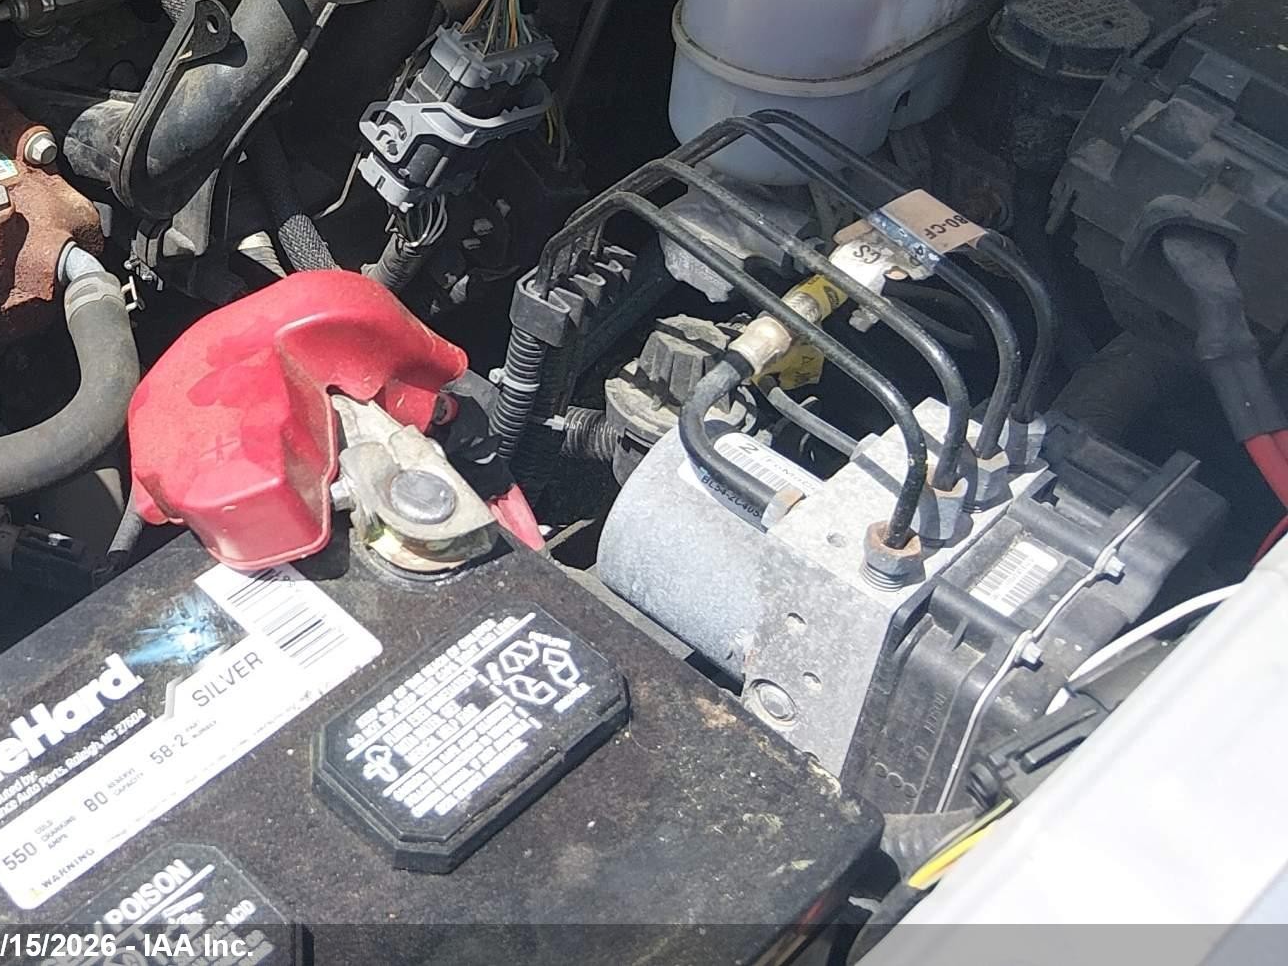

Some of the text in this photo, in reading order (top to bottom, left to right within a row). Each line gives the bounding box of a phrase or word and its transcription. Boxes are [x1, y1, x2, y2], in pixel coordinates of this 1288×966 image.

[191, 650, 265, 708] SILVER
[14, 780, 43, 805] Auto
[99, 728, 118, 745] NC
[147, 731, 190, 767] 58-2
[19, 769, 40, 789] by:
[81, 788, 110, 814] 80
[1, 840, 38, 872] 550
[38, 845, 98, 891] WARNING
[103, 858, 194, 930] POISON
[225, 899, 258, 927] ACID
